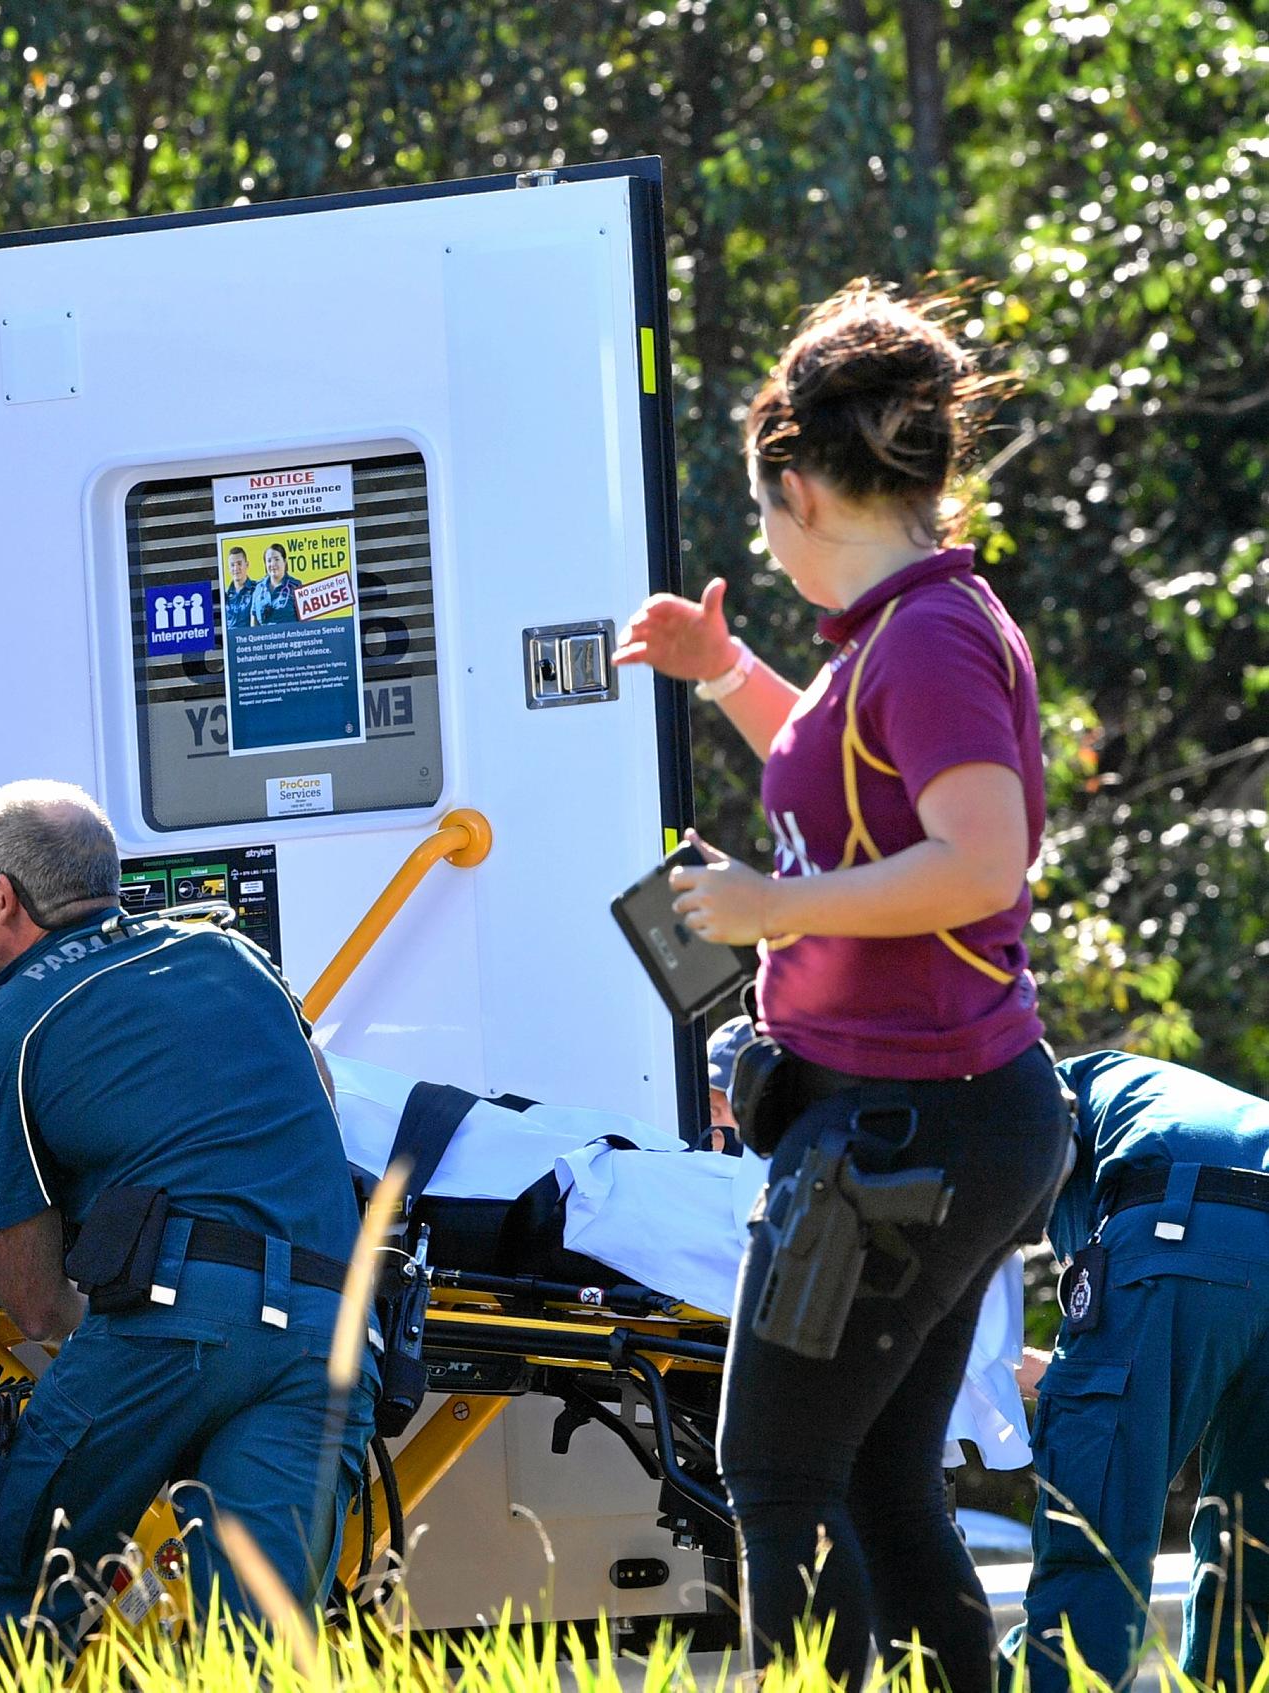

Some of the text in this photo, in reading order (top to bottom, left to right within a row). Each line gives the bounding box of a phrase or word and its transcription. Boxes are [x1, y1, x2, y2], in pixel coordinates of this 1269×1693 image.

[250, 472, 315, 488] NOTICE
[224, 485, 342, 503] Camera surveillance
[243, 502, 266, 510] may
[271, 500, 284, 508] be
[256, 510, 277, 518] this
[280, 505, 326, 516] vehicle.
[287, 535, 346, 552] We're here
[288, 551, 346, 572] TO HELP
[298, 578, 346, 598] NO excuse for
[302, 586, 349, 615] ABUSE
[152, 628, 210, 643] Interpreter
[248, 630, 286, 642] Queensland
[286, 629, 322, 638] Ambulance
[322, 626, 345, 634] Service
[264, 642, 289, 650] tolerate
[290, 638, 324, 648] aggressive
[236, 654, 268, 663] behaviour
[277, 649, 303, 660] physical
[304, 648, 332, 656] violence.
[280, 778, 320, 790] ProCare
[280, 788, 322, 800] Services
[244, 848, 274, 858] stryker
